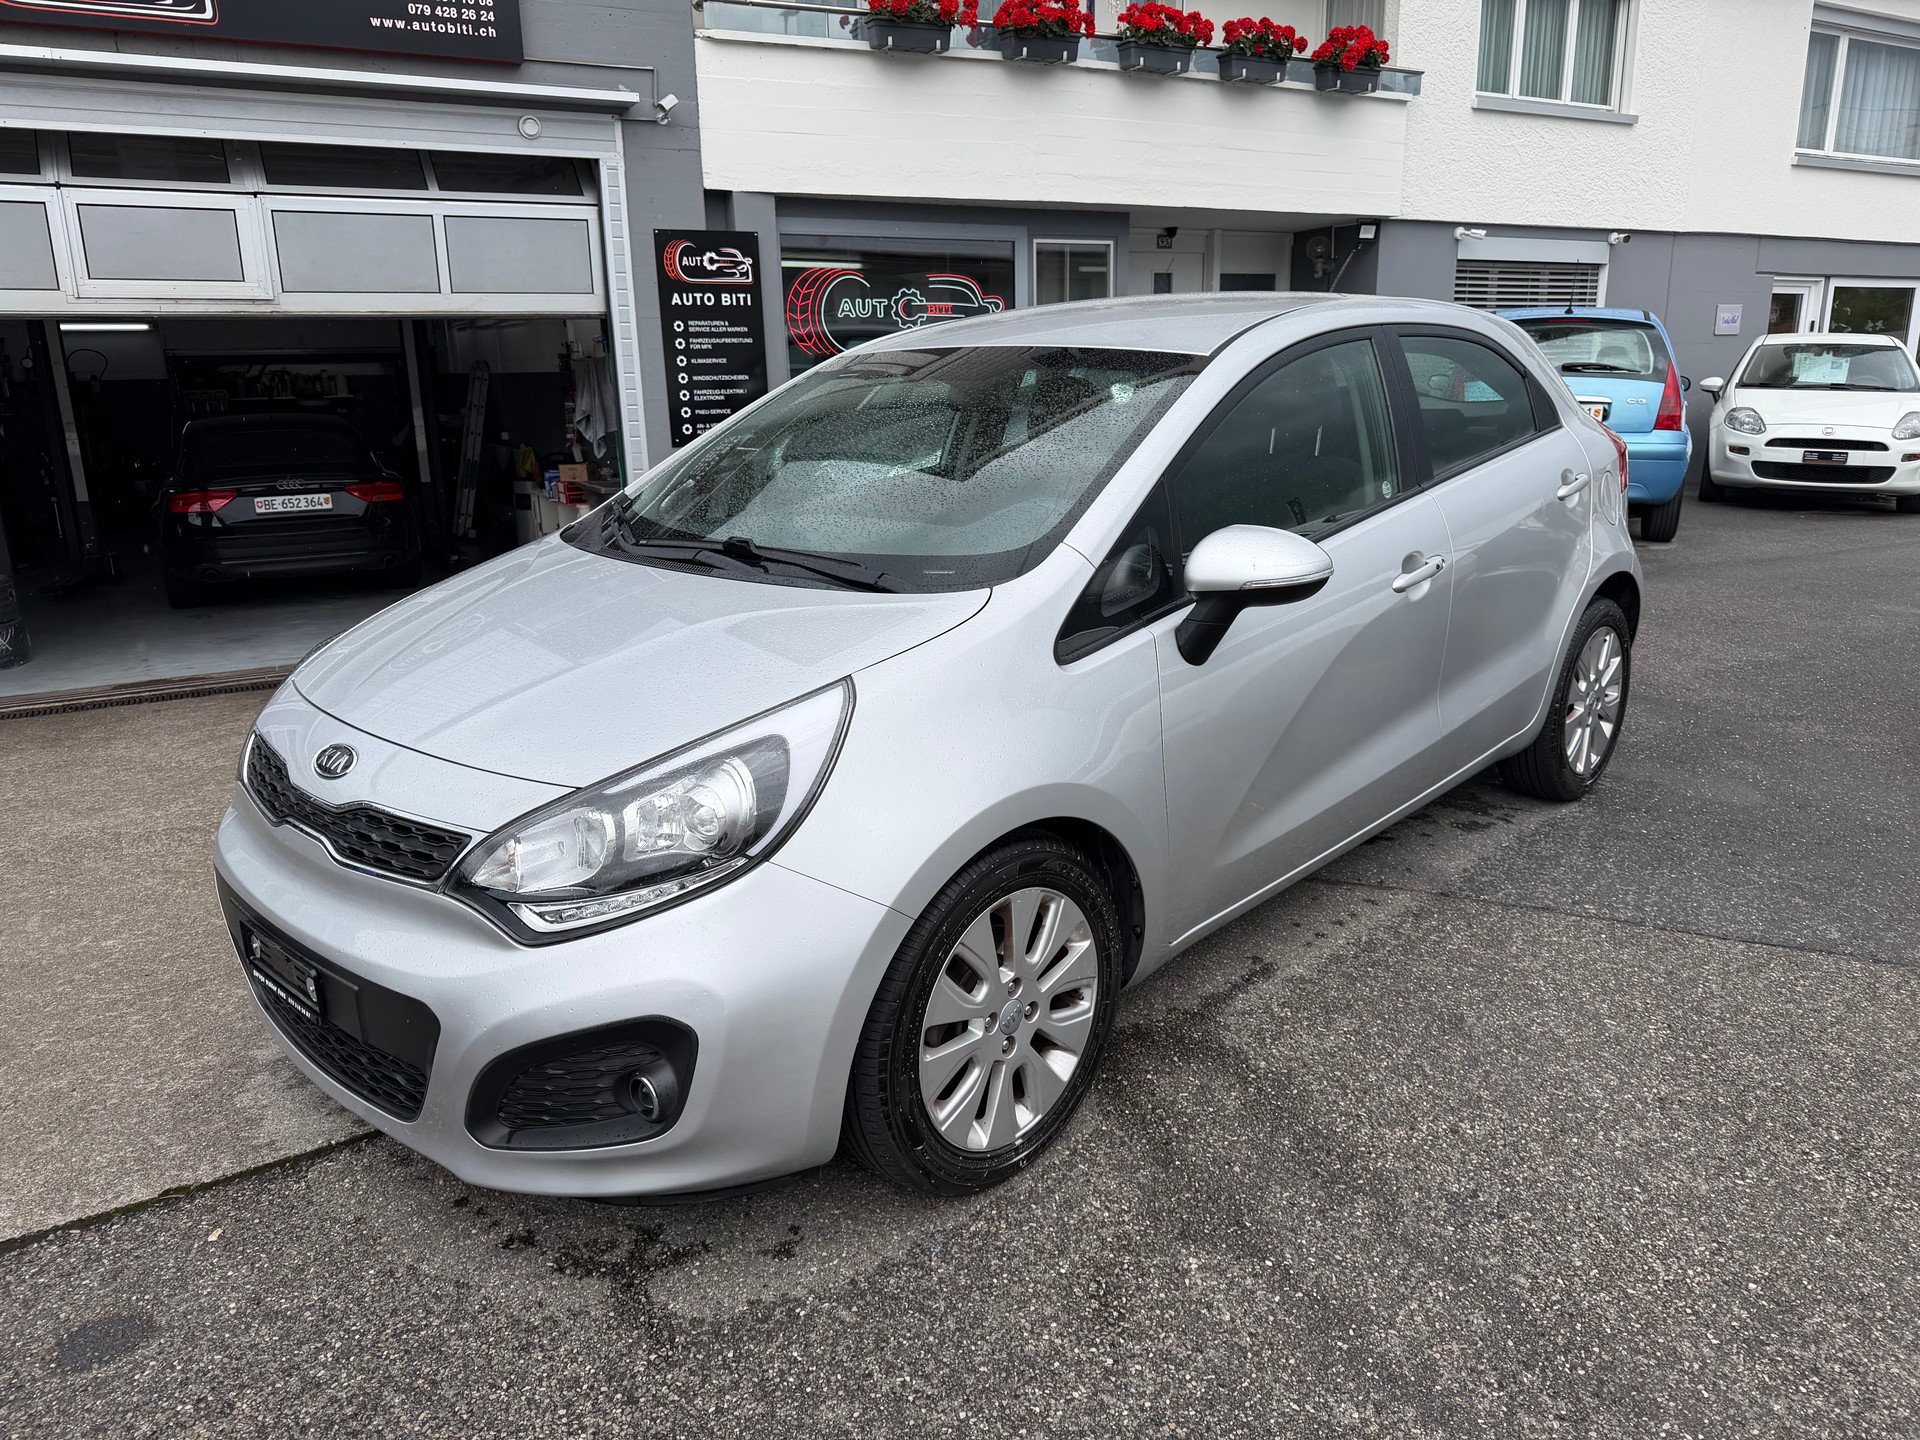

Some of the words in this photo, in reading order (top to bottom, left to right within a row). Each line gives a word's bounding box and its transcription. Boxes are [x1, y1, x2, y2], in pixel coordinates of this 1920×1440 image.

[408, 3, 431, 16] 079
[435, 6, 458, 19] 428
[461, 9, 477, 20] 26
[480, 11, 495, 22] 24
[370, 17, 497, 37] www.autobiti.ch
[671, 292, 715, 306] AUTO
[721, 293, 752, 306] BITI
[928, 304, 953, 315] BITI
[318, 748, 349, 774] KIA
